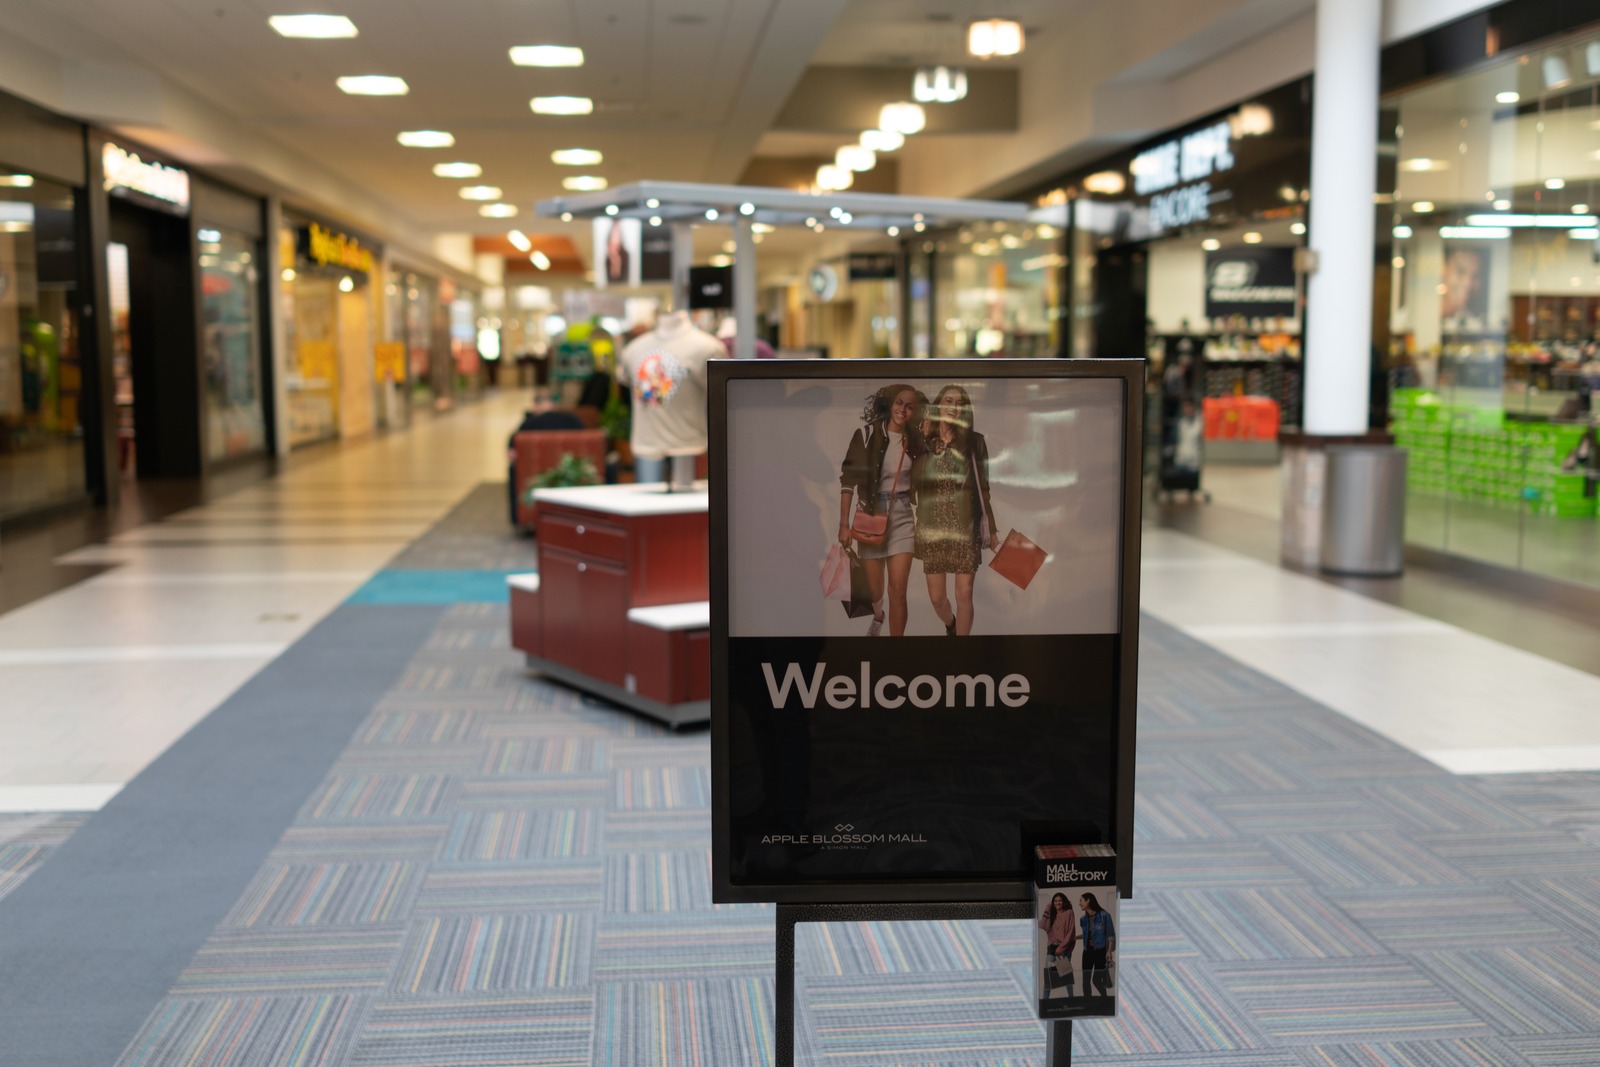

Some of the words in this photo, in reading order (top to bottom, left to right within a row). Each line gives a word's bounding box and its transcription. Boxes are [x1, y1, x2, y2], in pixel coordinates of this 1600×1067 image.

[761, 661, 1030, 709] Welcome
[761, 834, 809, 844] APPLE
[812, 833, 885, 844] BLOSSOM
[888, 833, 927, 843] MALL
[1046, 863, 1078, 874] MALL
[1046, 871, 1108, 883] DIRECTORY
